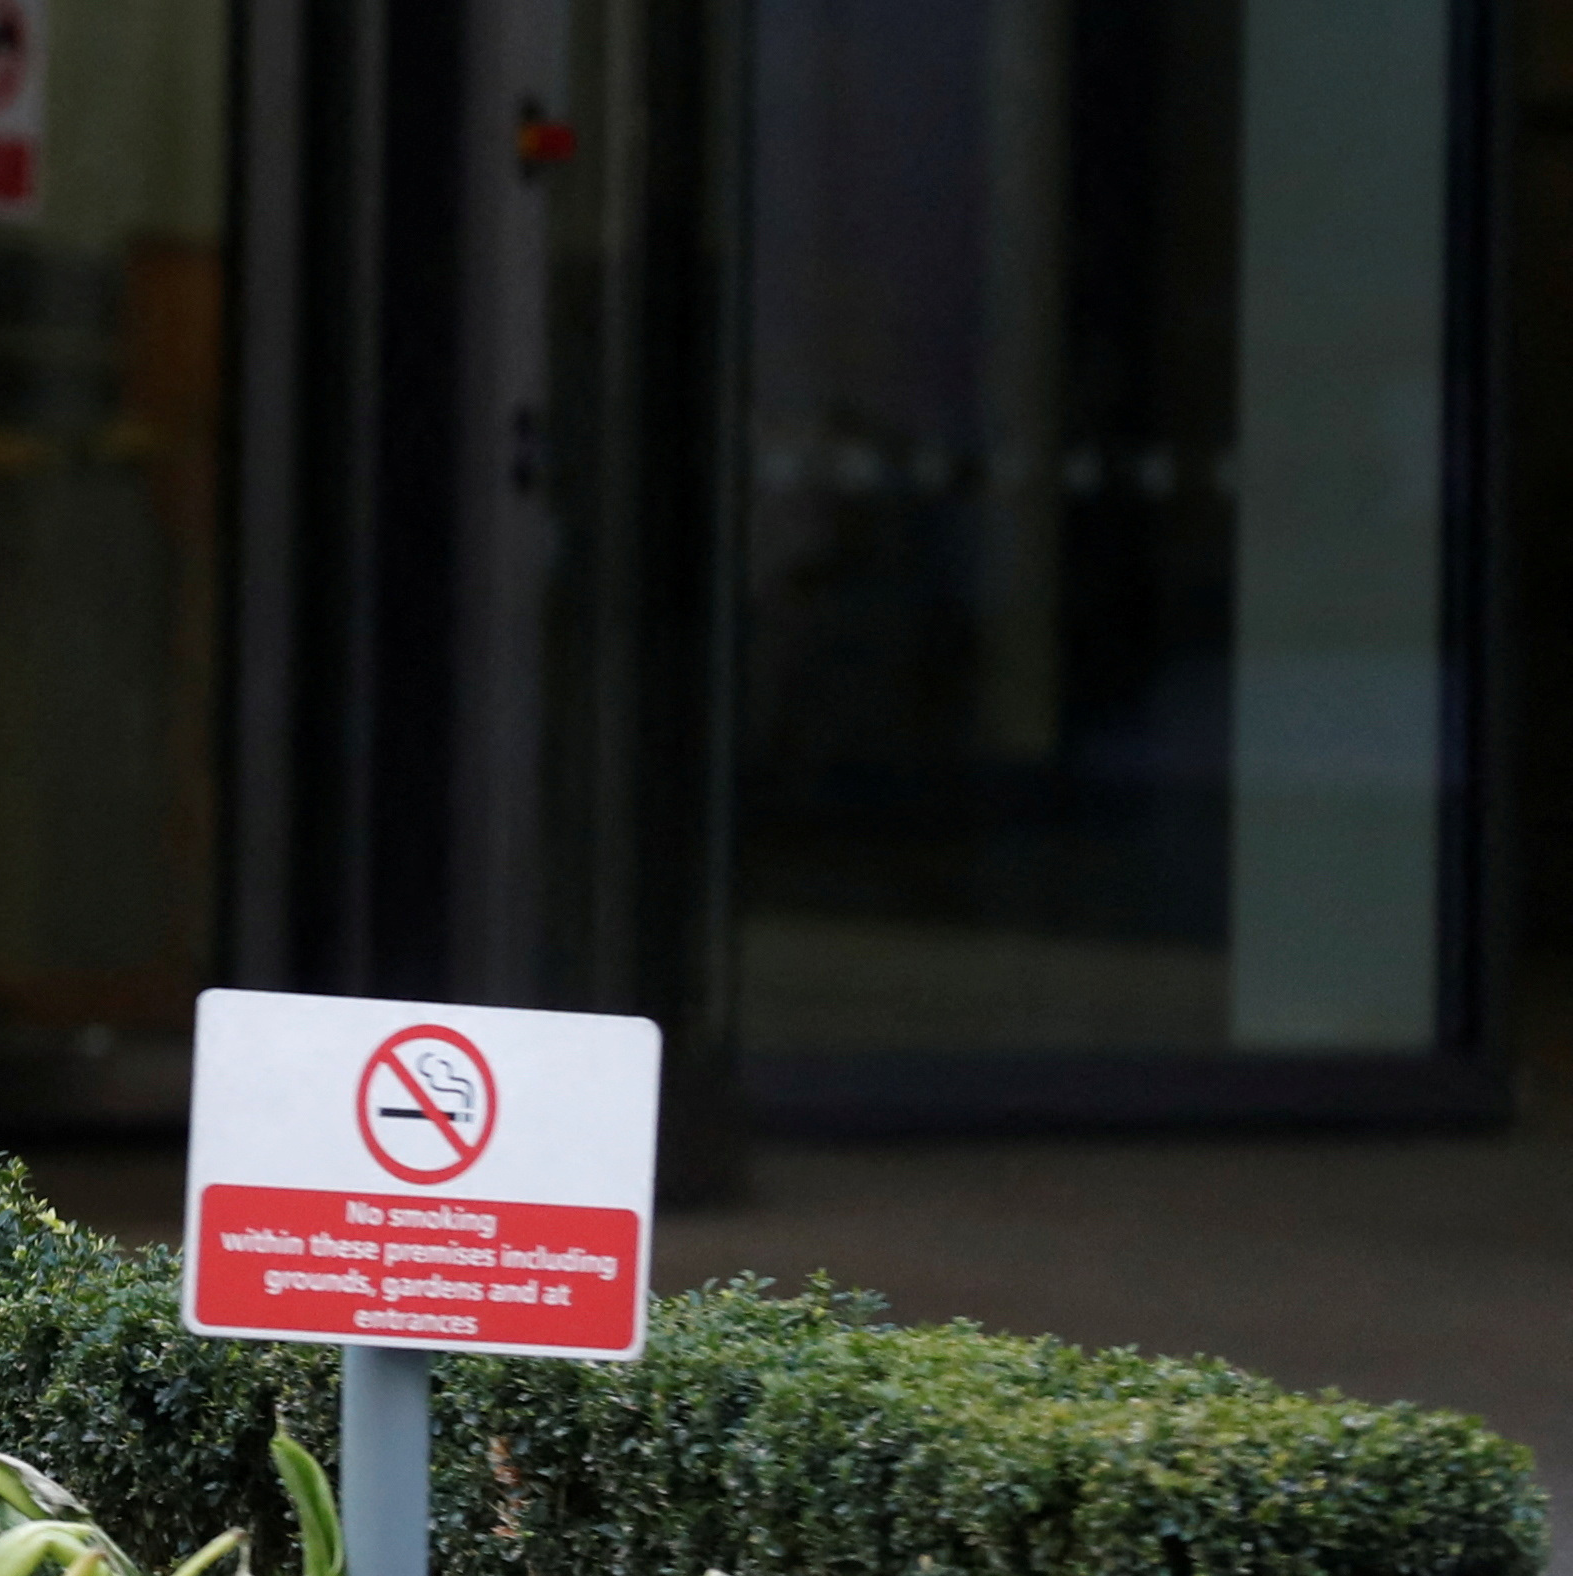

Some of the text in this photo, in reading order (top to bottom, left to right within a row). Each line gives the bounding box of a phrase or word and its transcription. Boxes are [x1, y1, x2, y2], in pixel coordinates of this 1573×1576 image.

[345, 1200, 498, 1239] No smoking
[221, 1227, 618, 1281] within these premises including
[264, 1266, 572, 1306] grounds, gardens and at
[353, 1308, 478, 1336] entrances
